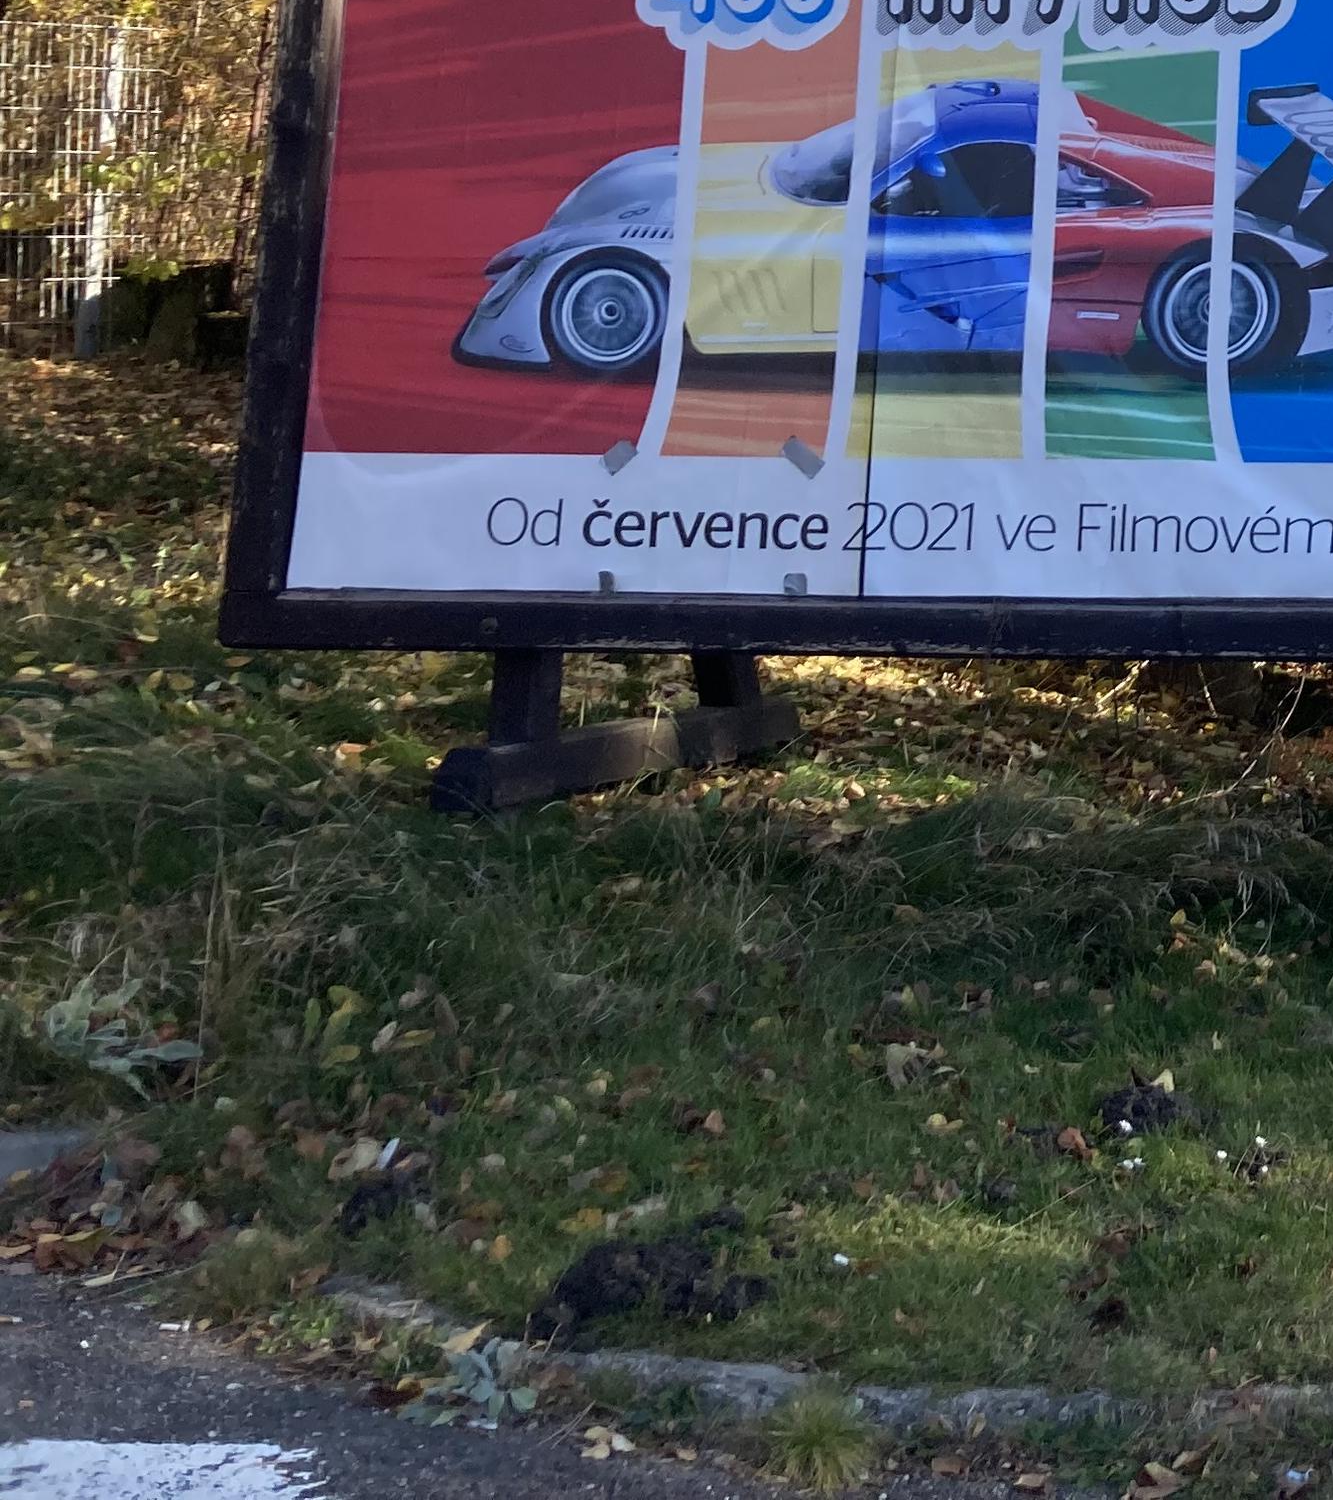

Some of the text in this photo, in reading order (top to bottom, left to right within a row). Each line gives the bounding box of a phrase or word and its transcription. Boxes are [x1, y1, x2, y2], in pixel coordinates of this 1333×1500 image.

[487, 497, 564, 546] Od
[582, 498, 829, 550] července
[996, 513, 1057, 552] ve
